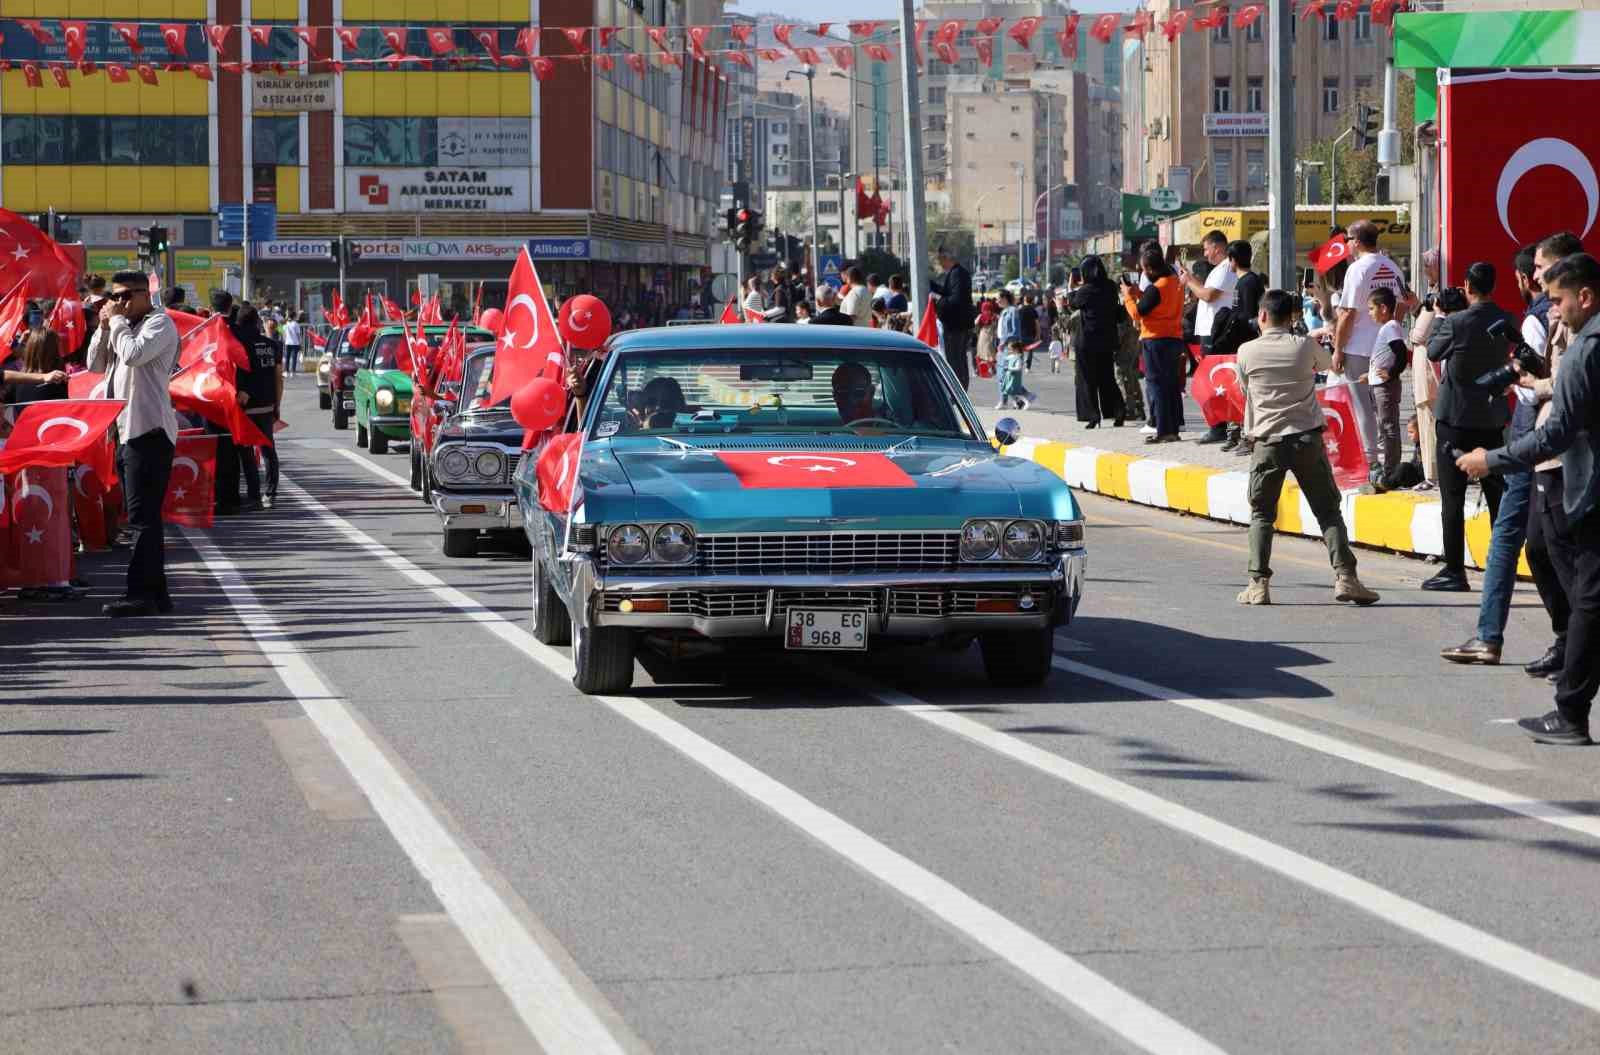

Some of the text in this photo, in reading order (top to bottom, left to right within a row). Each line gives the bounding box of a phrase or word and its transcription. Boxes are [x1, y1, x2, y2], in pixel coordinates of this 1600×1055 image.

[424, 170, 487, 182] SATAM
[400, 186, 513, 196] ARABULUCULUK
[118, 226, 177, 240] BOH
[268, 242, 328, 254] erdem
[406, 242, 461, 256] NEOVA
[795, 612, 862, 628] 38 EG
[811, 630, 841, 646] 968
